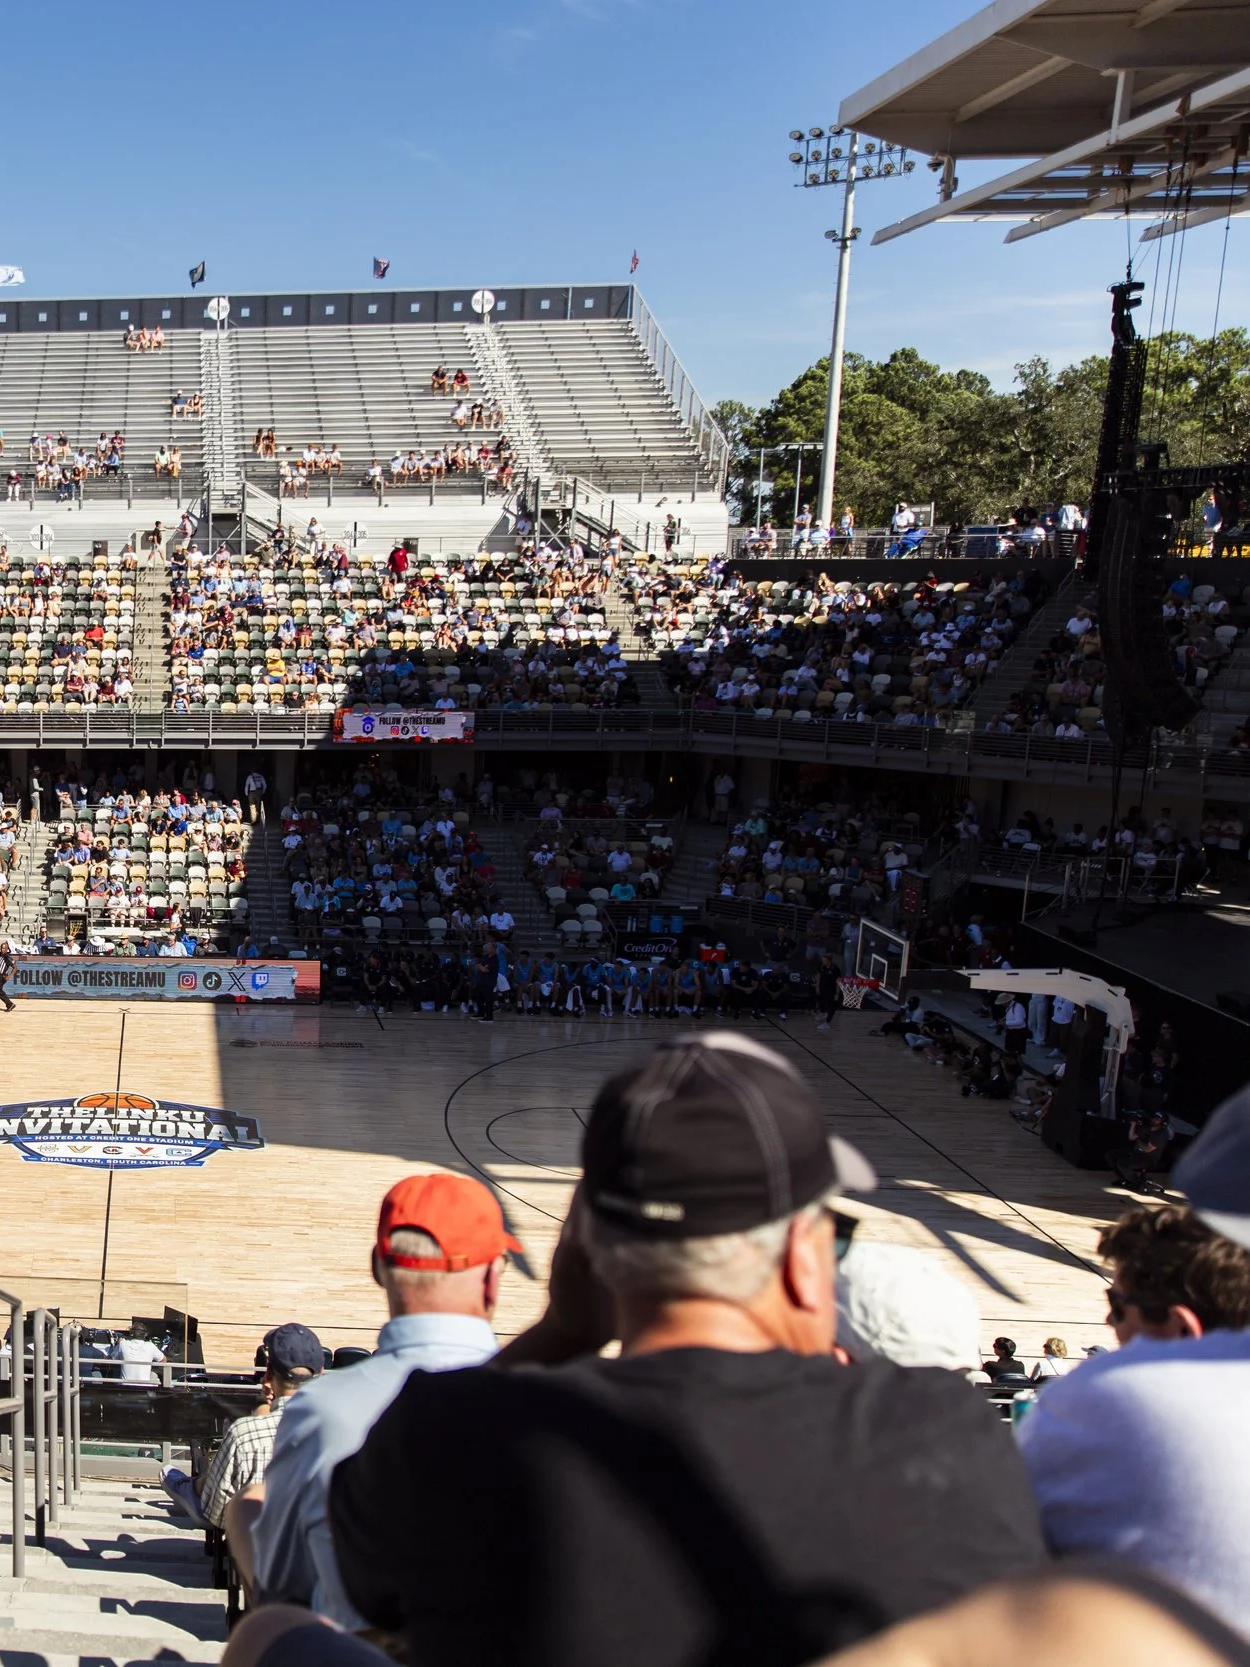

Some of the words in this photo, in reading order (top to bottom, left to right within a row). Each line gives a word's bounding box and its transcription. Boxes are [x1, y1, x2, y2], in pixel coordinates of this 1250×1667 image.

[379, 717, 401, 725] FOLLOW
[402, 717, 446, 725] @THESTREAMU
[13, 969, 63, 986] FOLLOW
[67, 970, 166, 988] @THESTREAMU
[148, 1137, 194, 1145] STADIUM
